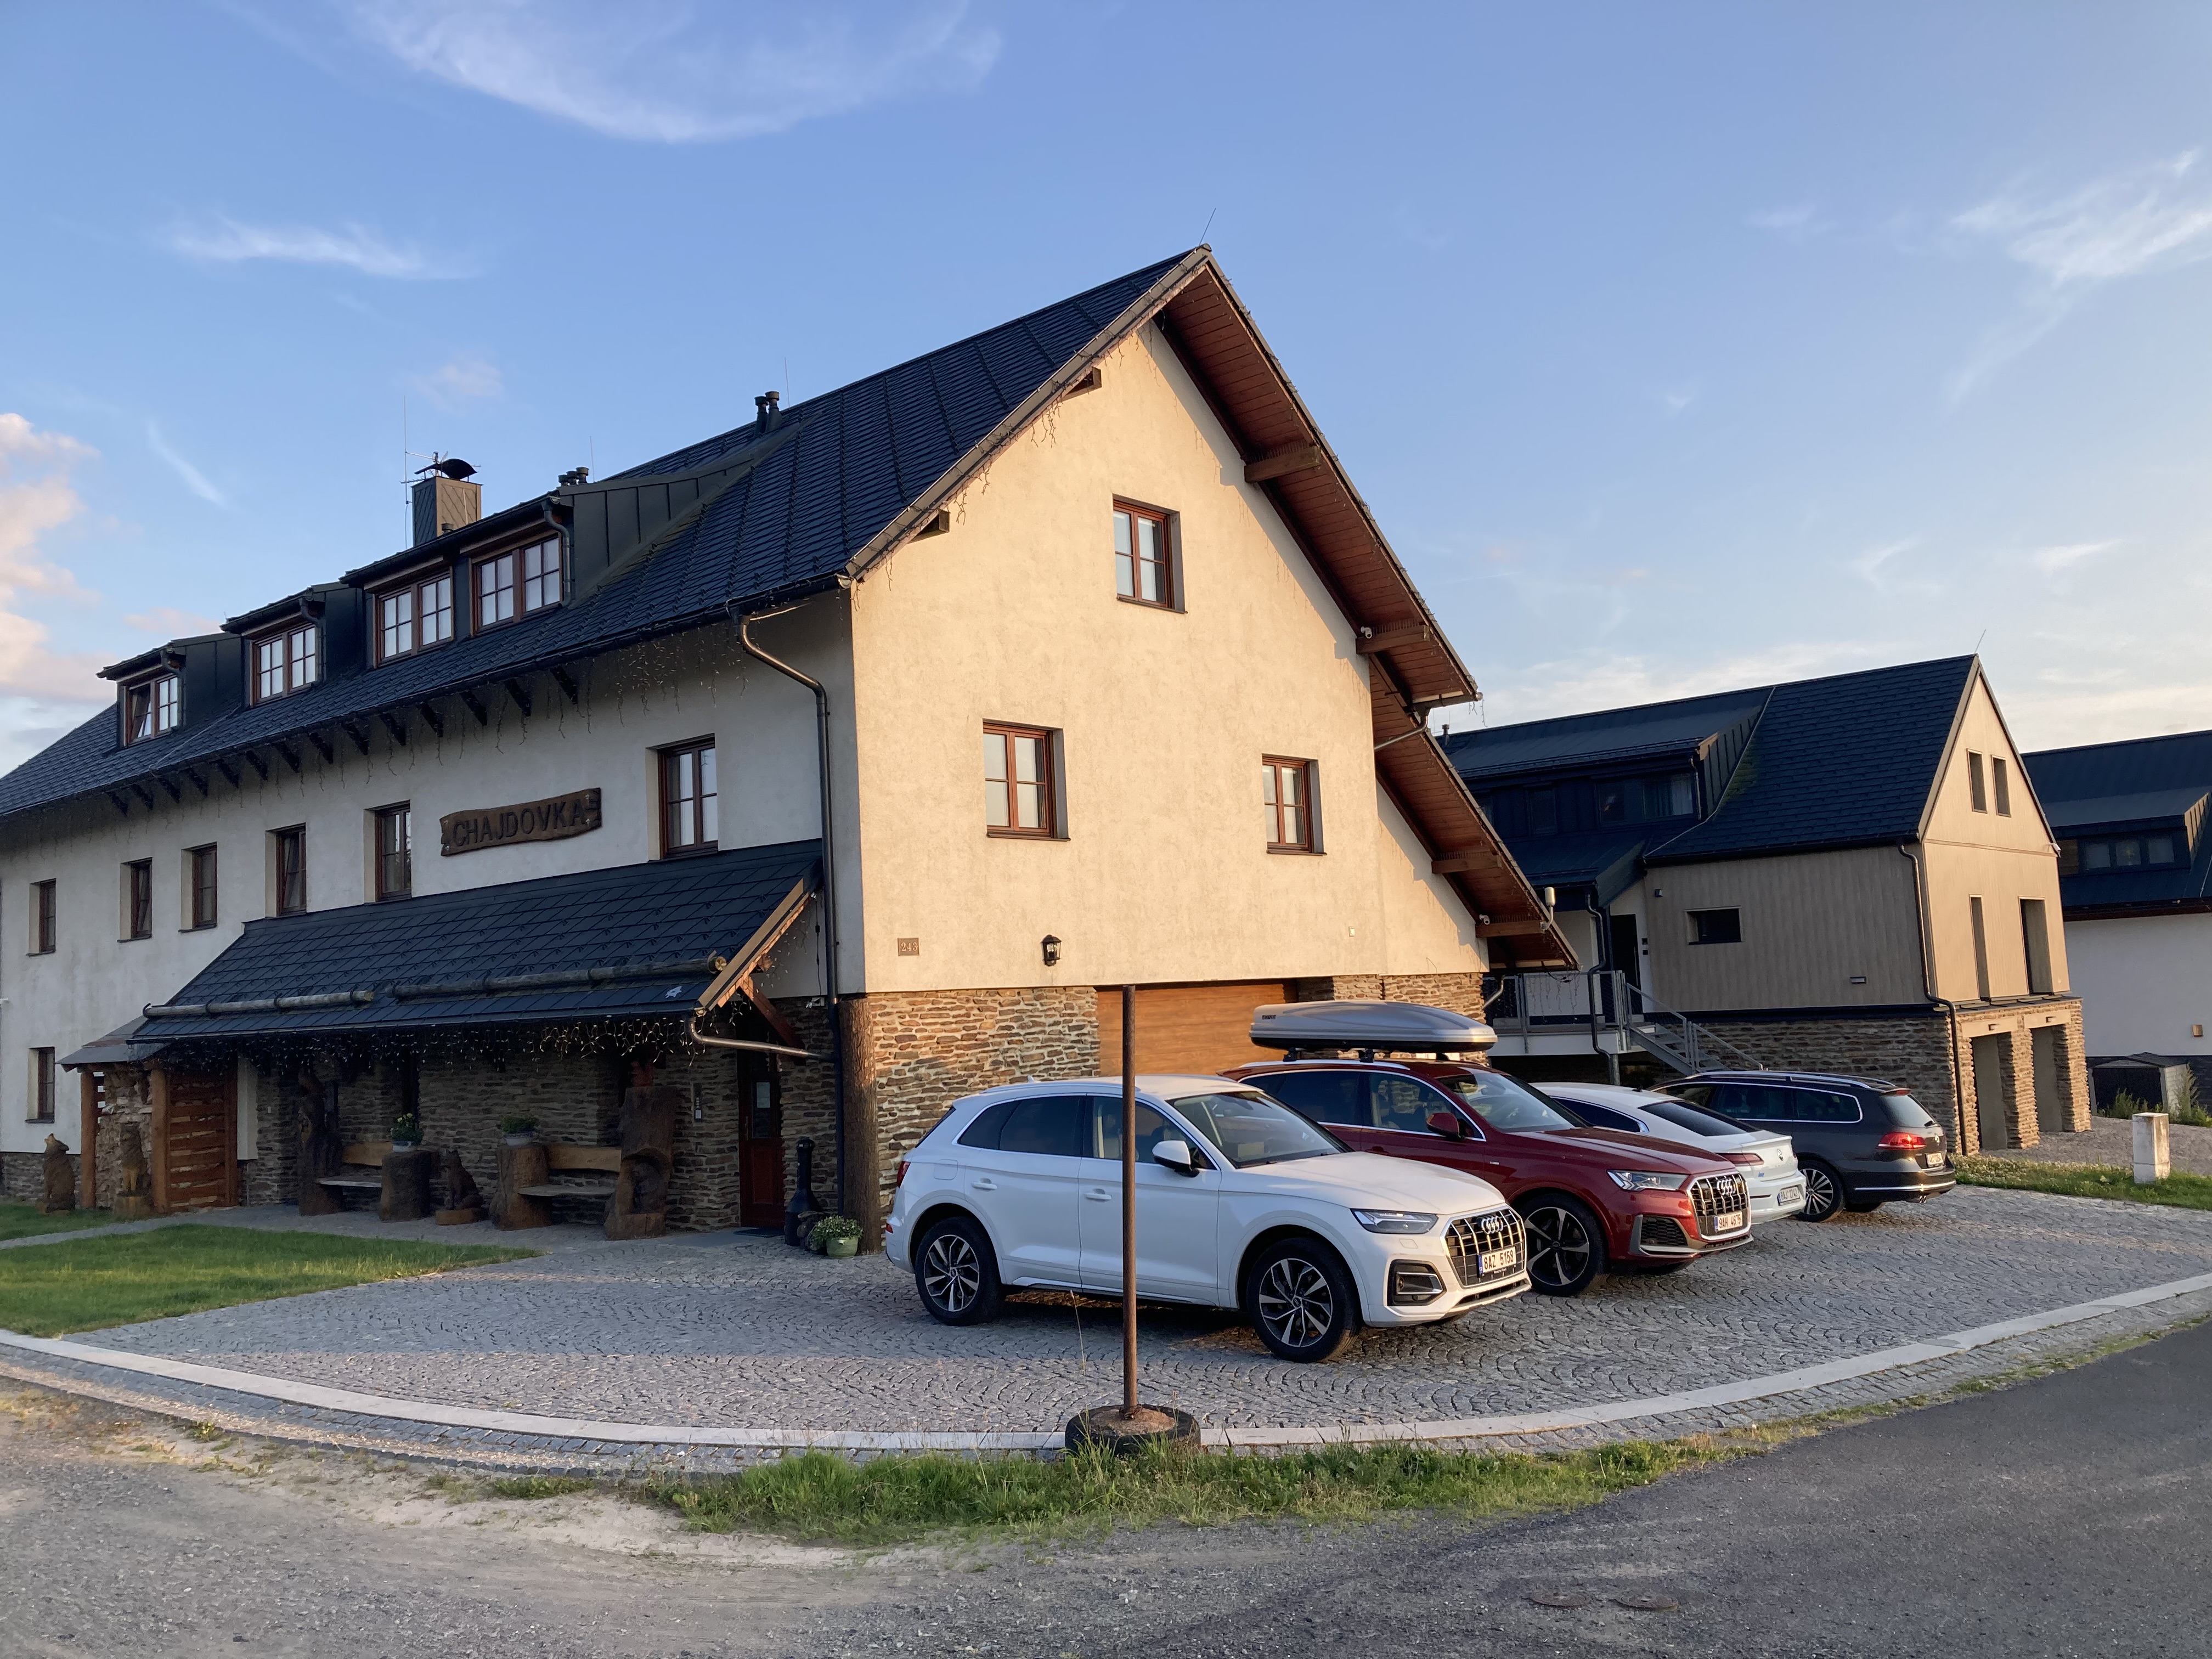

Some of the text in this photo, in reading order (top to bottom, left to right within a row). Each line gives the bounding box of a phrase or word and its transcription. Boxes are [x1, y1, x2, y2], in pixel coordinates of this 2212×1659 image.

[452, 798, 585, 847] CHAJDOVKA
[901, 941, 918, 952] 243
[1484, 1249, 1514, 1270] 8AZ 5158
